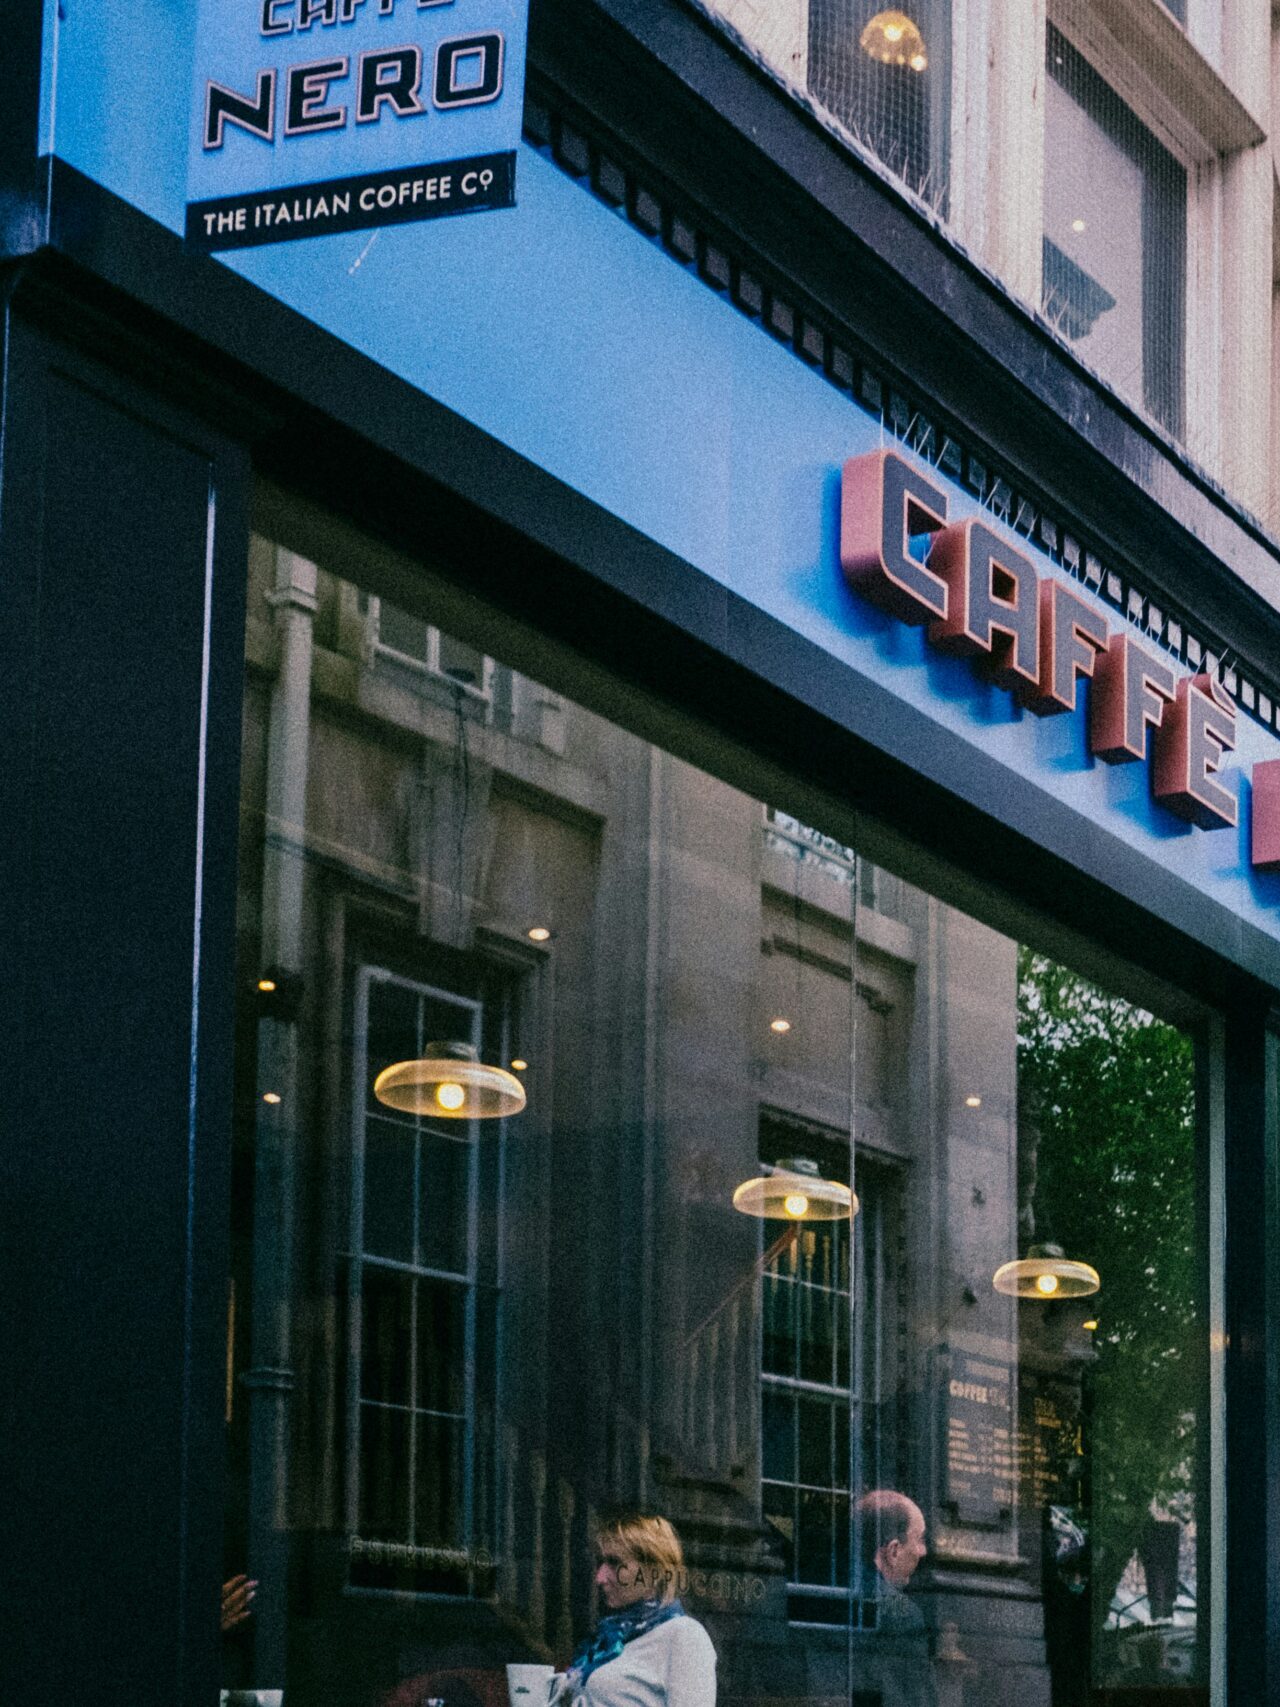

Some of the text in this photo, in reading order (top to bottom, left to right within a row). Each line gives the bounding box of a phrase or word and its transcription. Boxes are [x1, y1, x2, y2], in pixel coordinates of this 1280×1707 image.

[202, 29, 506, 149] NERO
[203, 207, 247, 236] THE
[254, 191, 351, 227] ITALIAN
[358, 174, 452, 213] COFFEE
